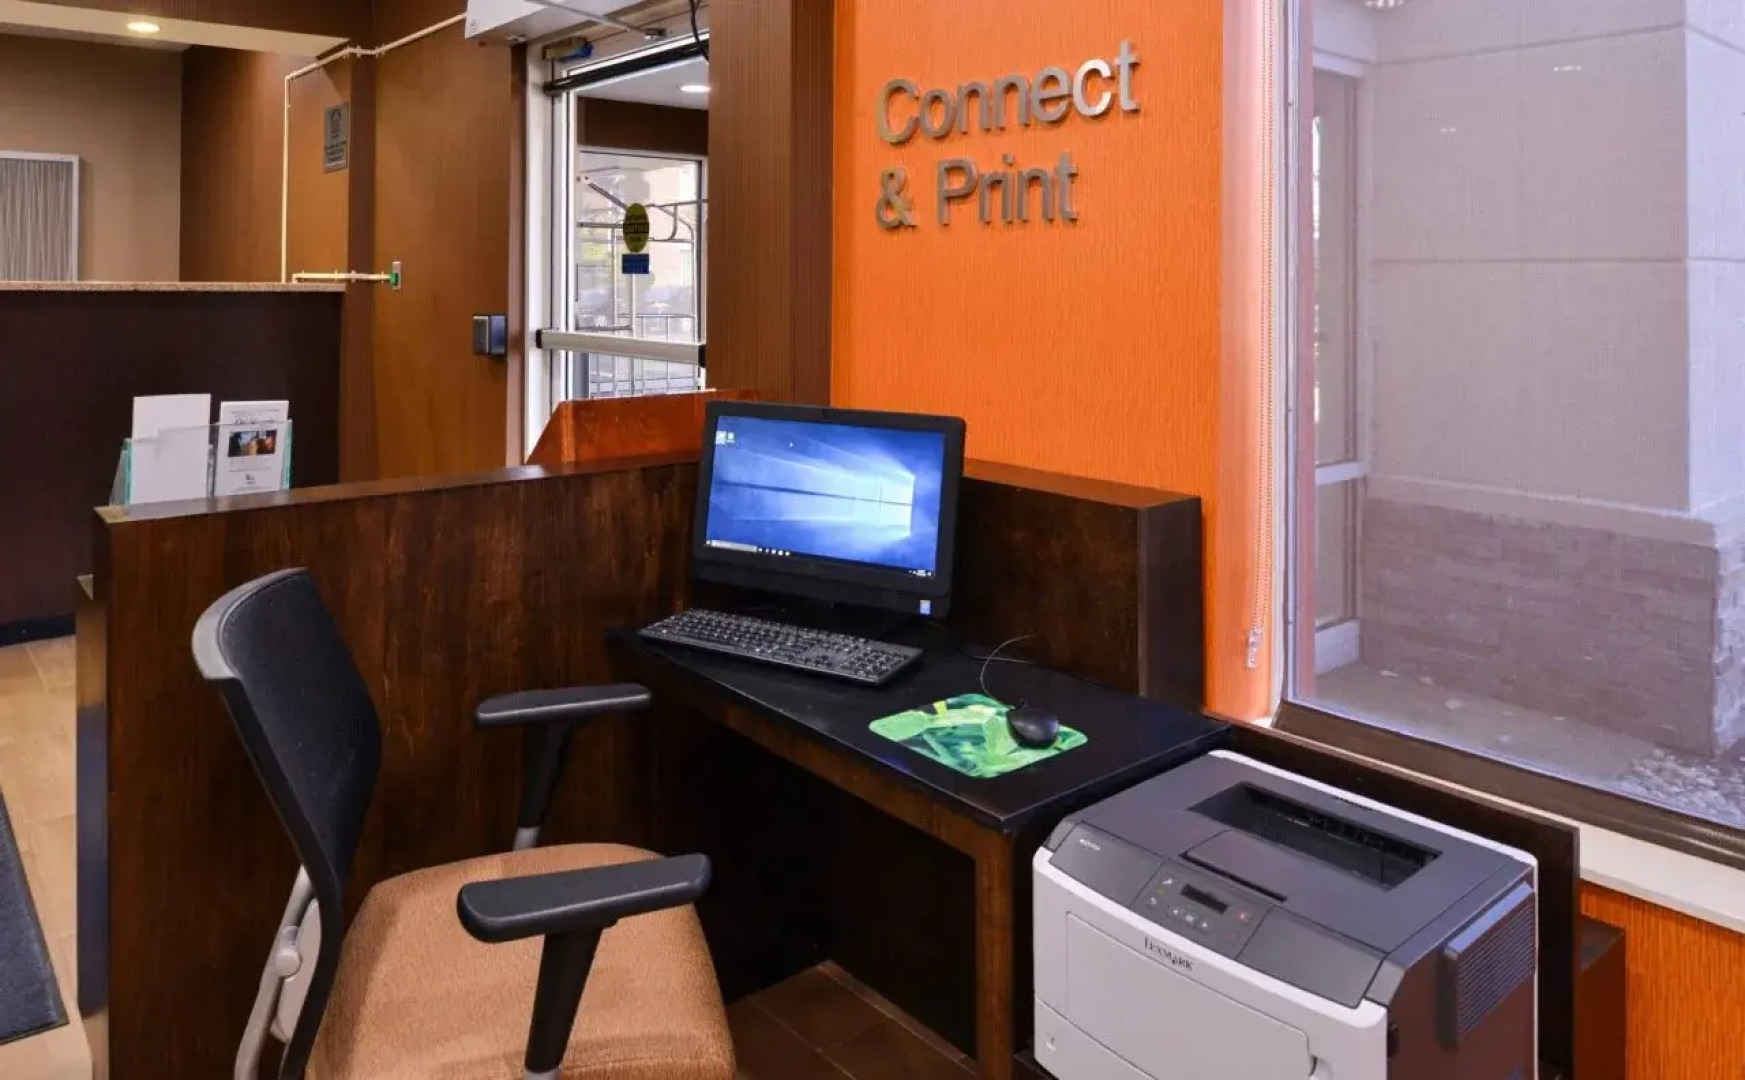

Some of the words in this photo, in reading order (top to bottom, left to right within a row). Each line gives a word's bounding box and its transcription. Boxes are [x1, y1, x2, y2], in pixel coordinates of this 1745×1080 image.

[879, 41, 1140, 143] Connect
[877, 168, 917, 228] &
[938, 152, 1079, 225] Print
